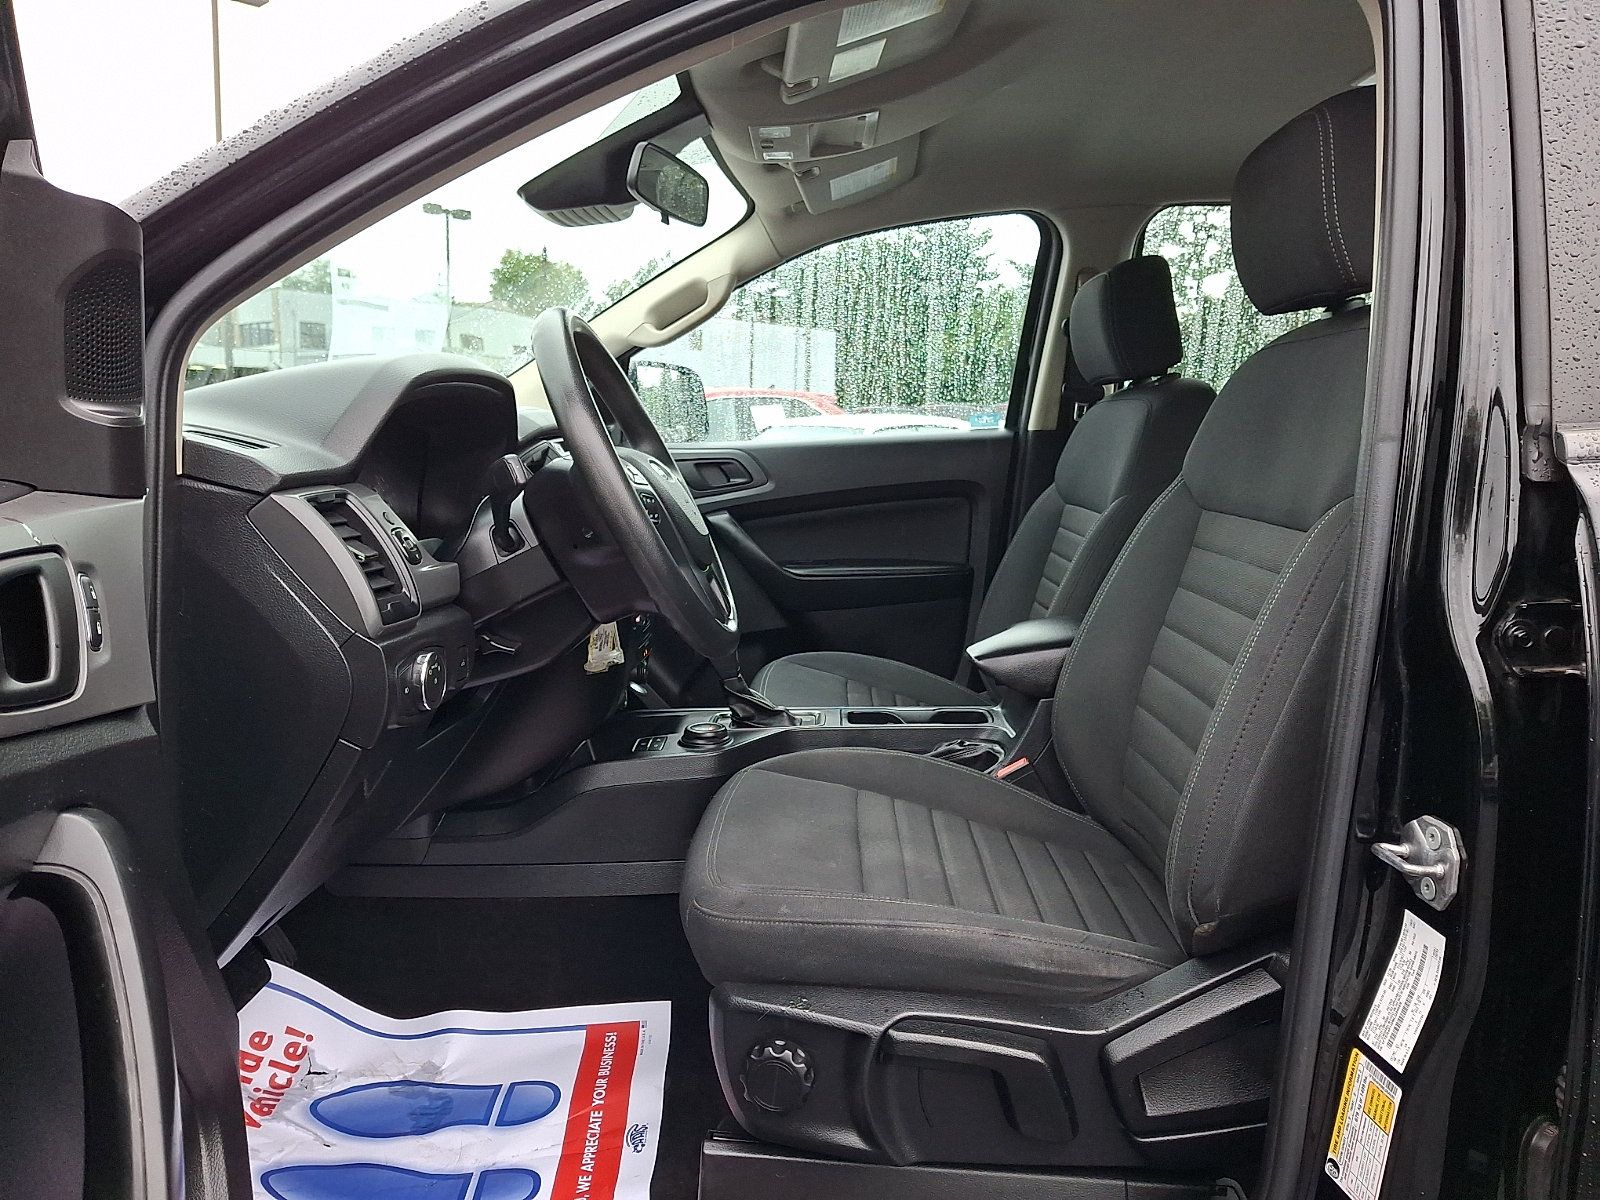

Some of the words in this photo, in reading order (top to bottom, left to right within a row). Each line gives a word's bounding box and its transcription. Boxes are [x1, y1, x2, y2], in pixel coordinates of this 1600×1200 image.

[598, 1031, 618, 1076] BUSINESS!
[1346, 1051, 1359, 1096] INFORMATION
[592, 1077, 609, 1107] YOUR
[581, 1110, 603, 1172] APPRECIATE
[576, 1174, 592, 1194] WE
